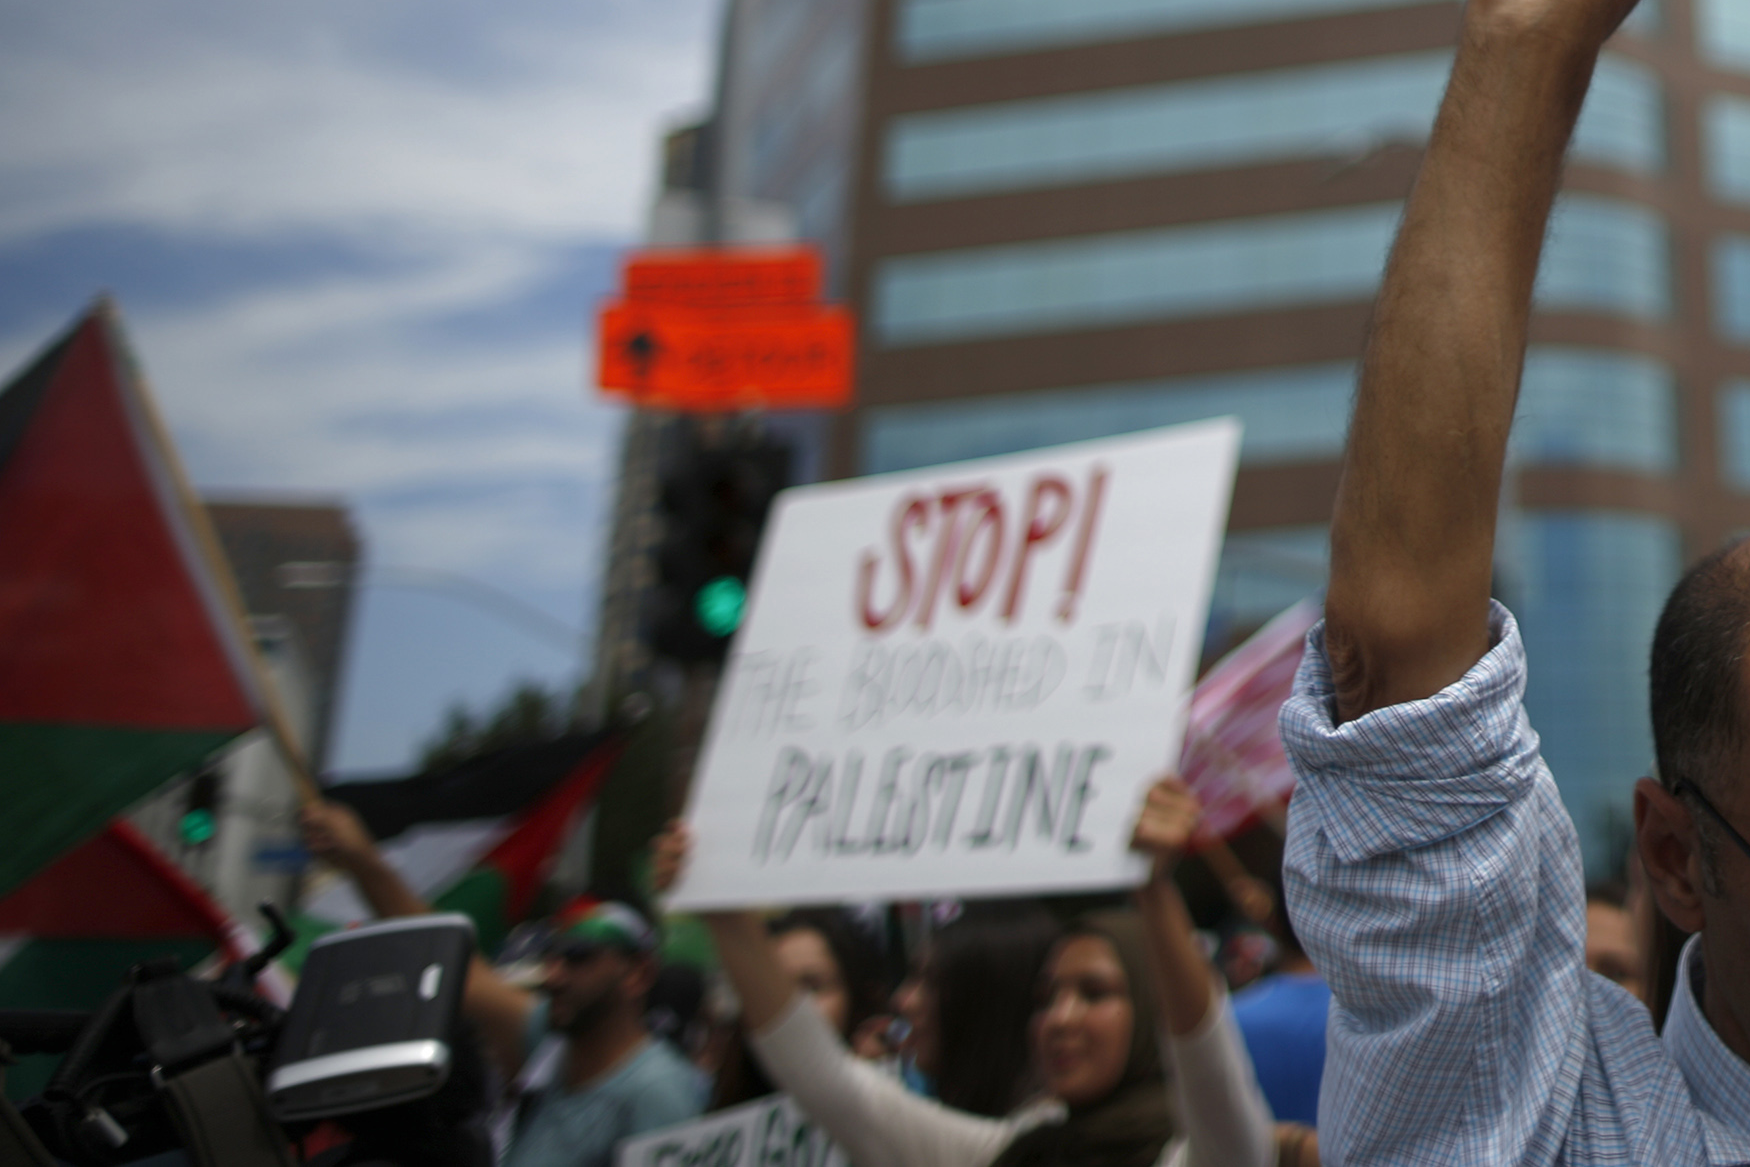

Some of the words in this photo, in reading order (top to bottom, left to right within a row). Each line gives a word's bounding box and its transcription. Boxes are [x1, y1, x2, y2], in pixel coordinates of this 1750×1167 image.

[856, 460, 1111, 635] STOP!
[728, 646, 824, 739] THE
[1080, 614, 1178, 704] IN
[751, 742, 1113, 862] PALESTINE
